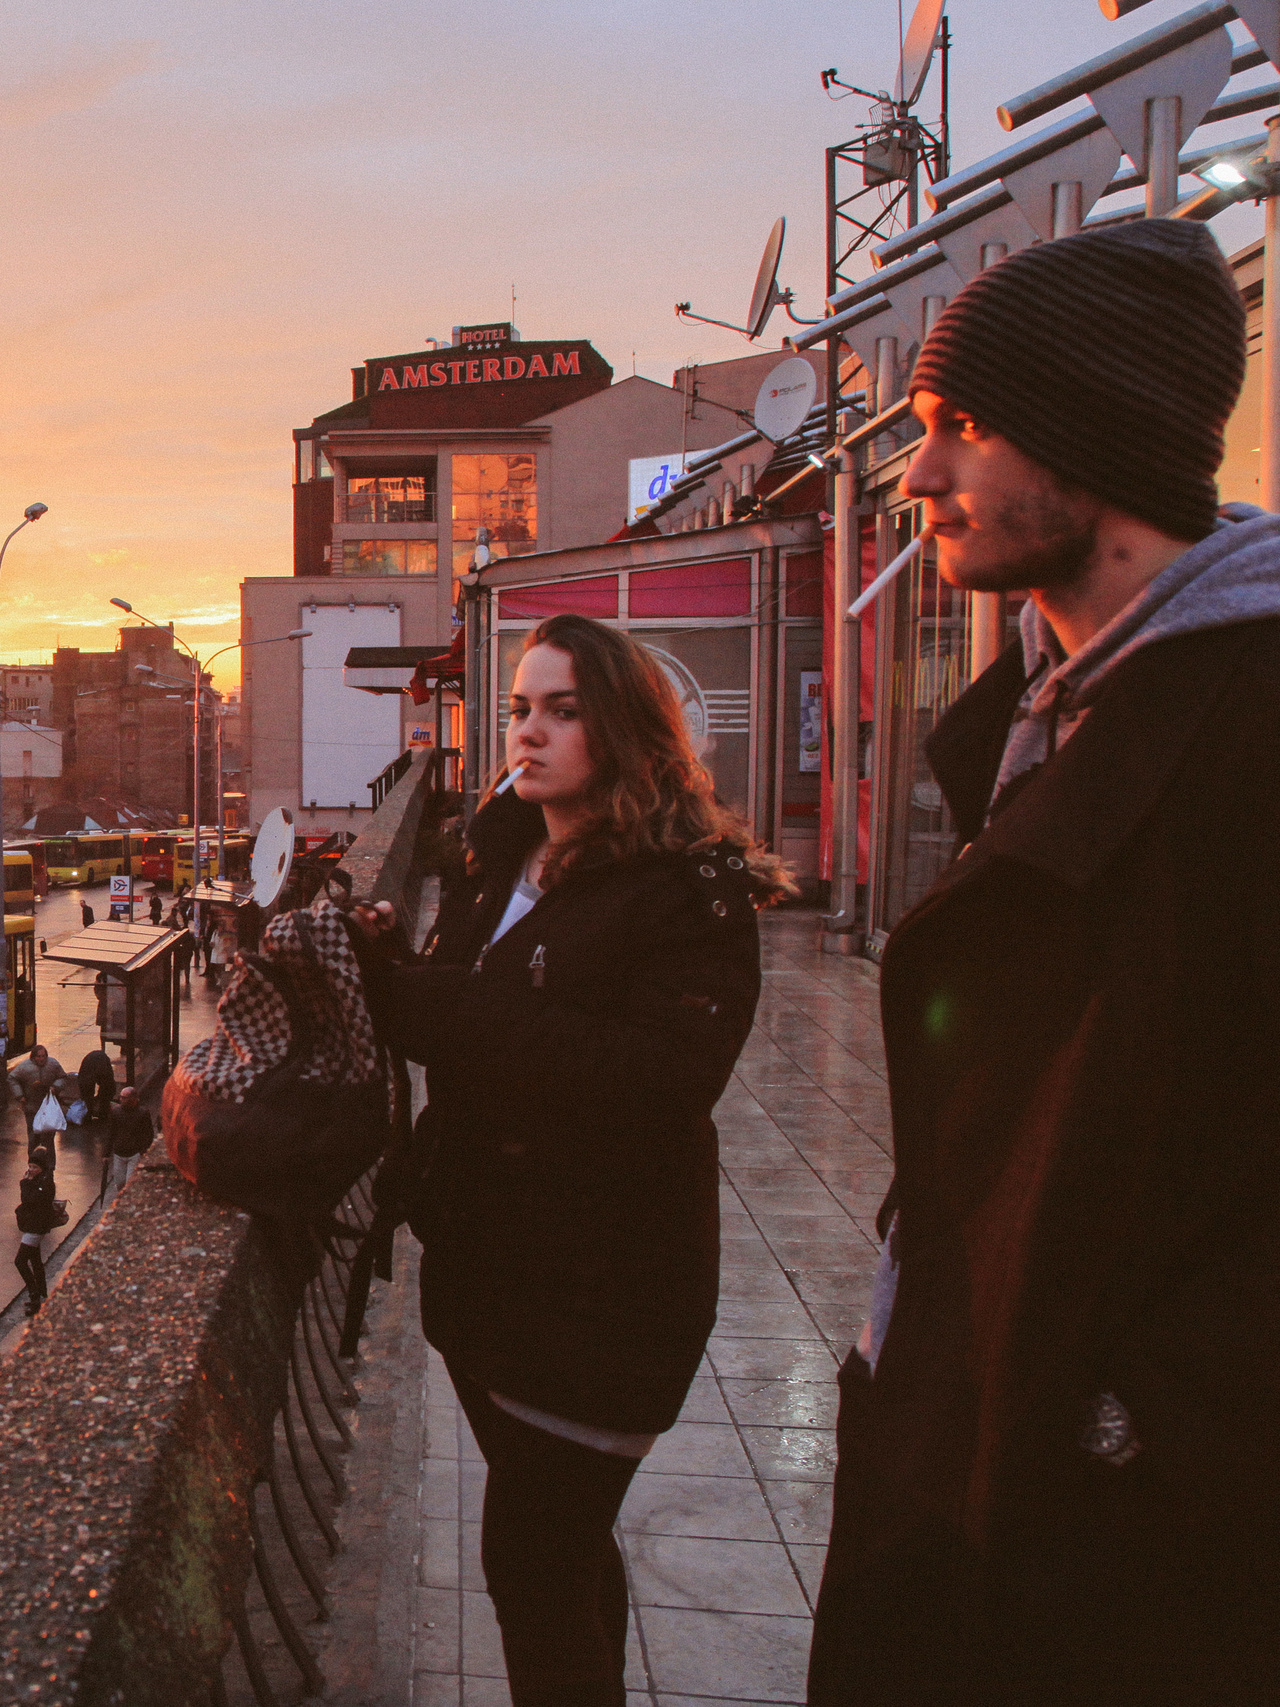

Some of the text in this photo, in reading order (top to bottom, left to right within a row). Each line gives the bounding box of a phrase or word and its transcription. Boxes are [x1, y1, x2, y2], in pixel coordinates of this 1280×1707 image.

[462, 328, 507, 343] HOTEL
[377, 351, 582, 391] AMSTERDAM
[648, 464, 686, 500] d
[412, 727, 431, 741] dm
